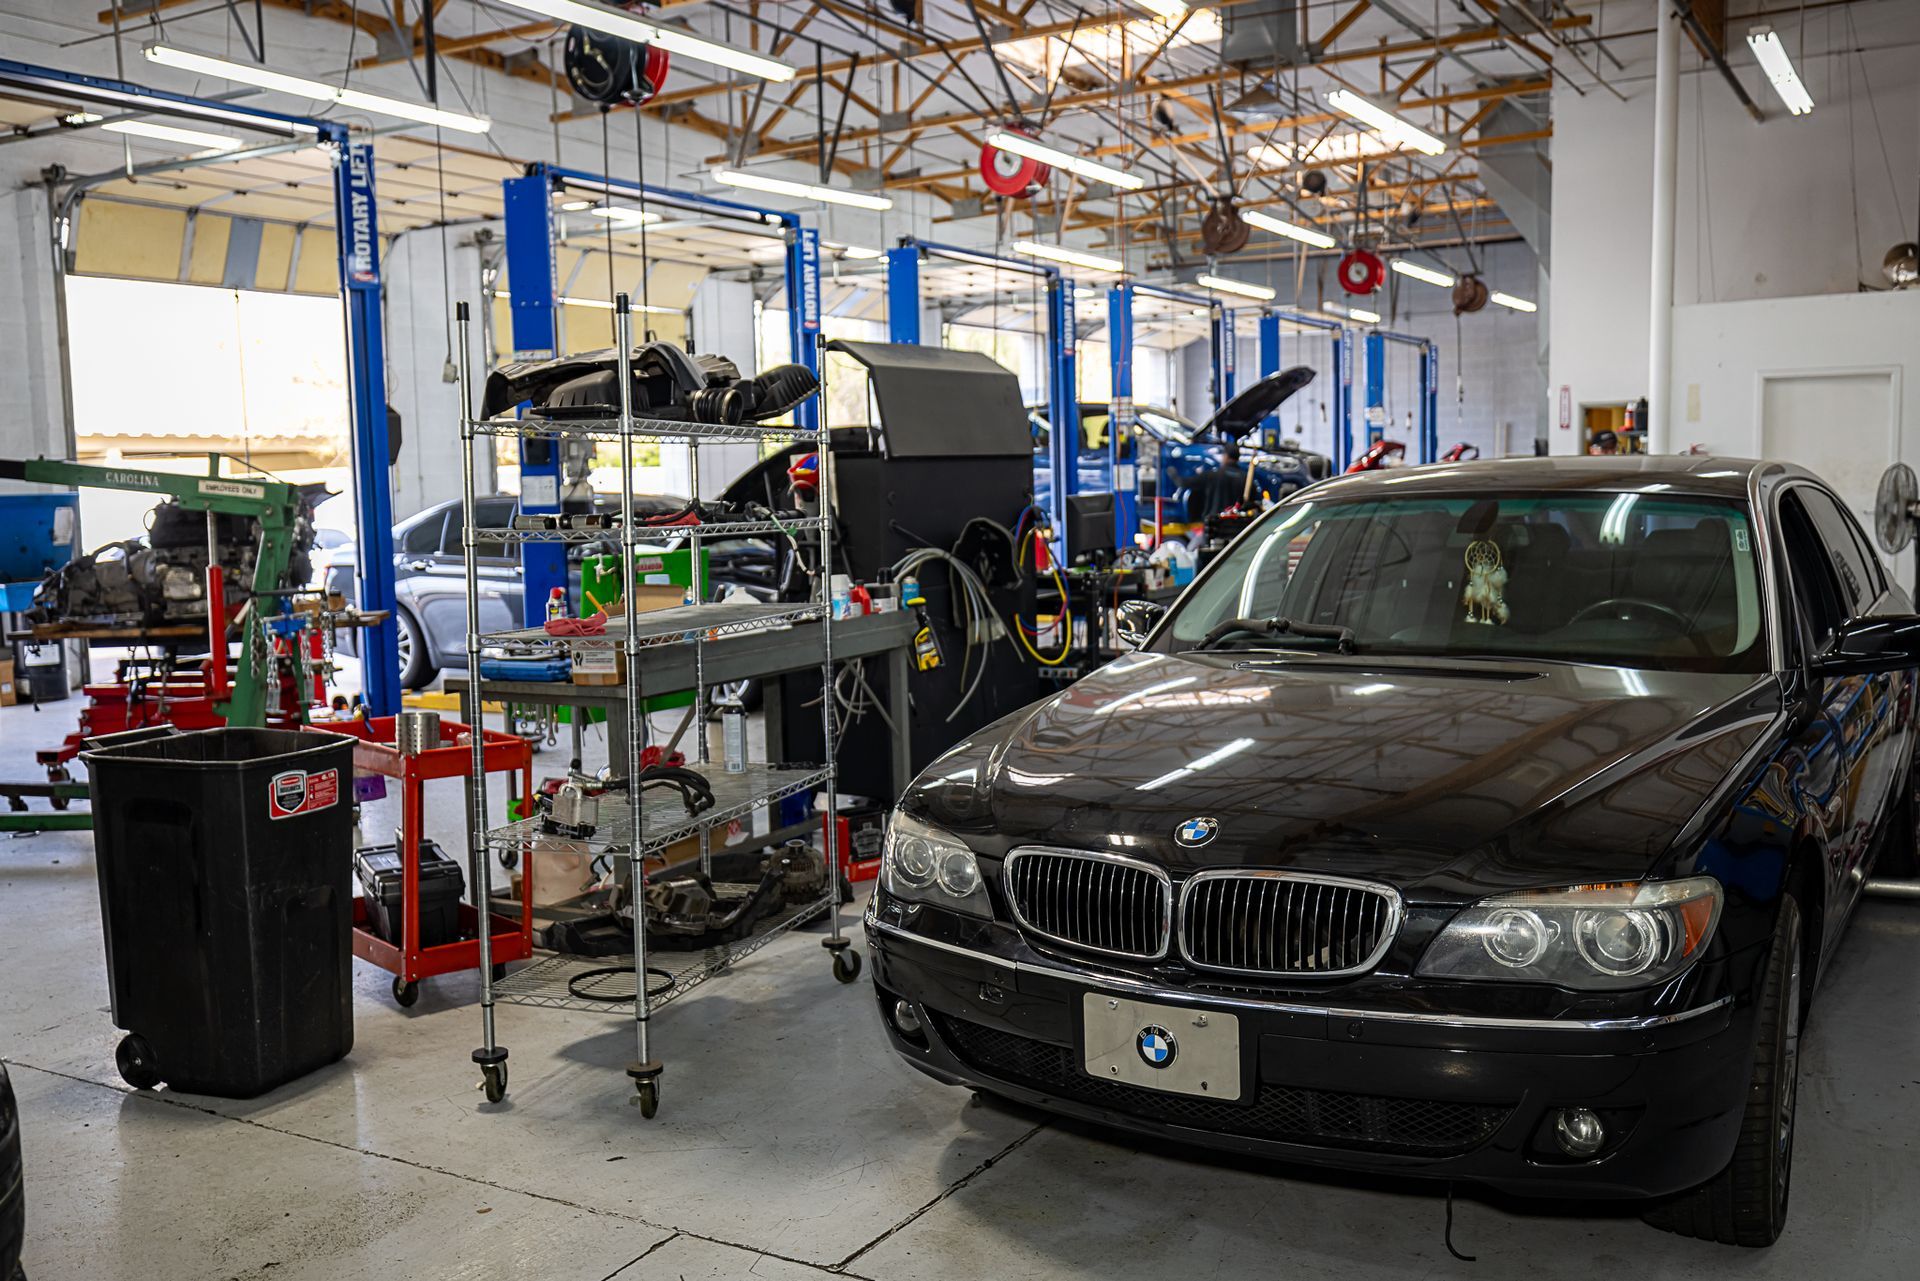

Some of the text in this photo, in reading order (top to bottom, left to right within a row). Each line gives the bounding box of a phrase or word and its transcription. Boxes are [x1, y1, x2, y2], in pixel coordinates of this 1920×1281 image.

[350, 143, 372, 271] ROTARY LIFT
[802, 230, 817, 320] ROTARY LIFT
[1063, 280, 1073, 348] ROTARY LIFT
[105, 471, 160, 487] CAROLINA
[205, 484, 257, 495] EMPLOYEES ONLY
